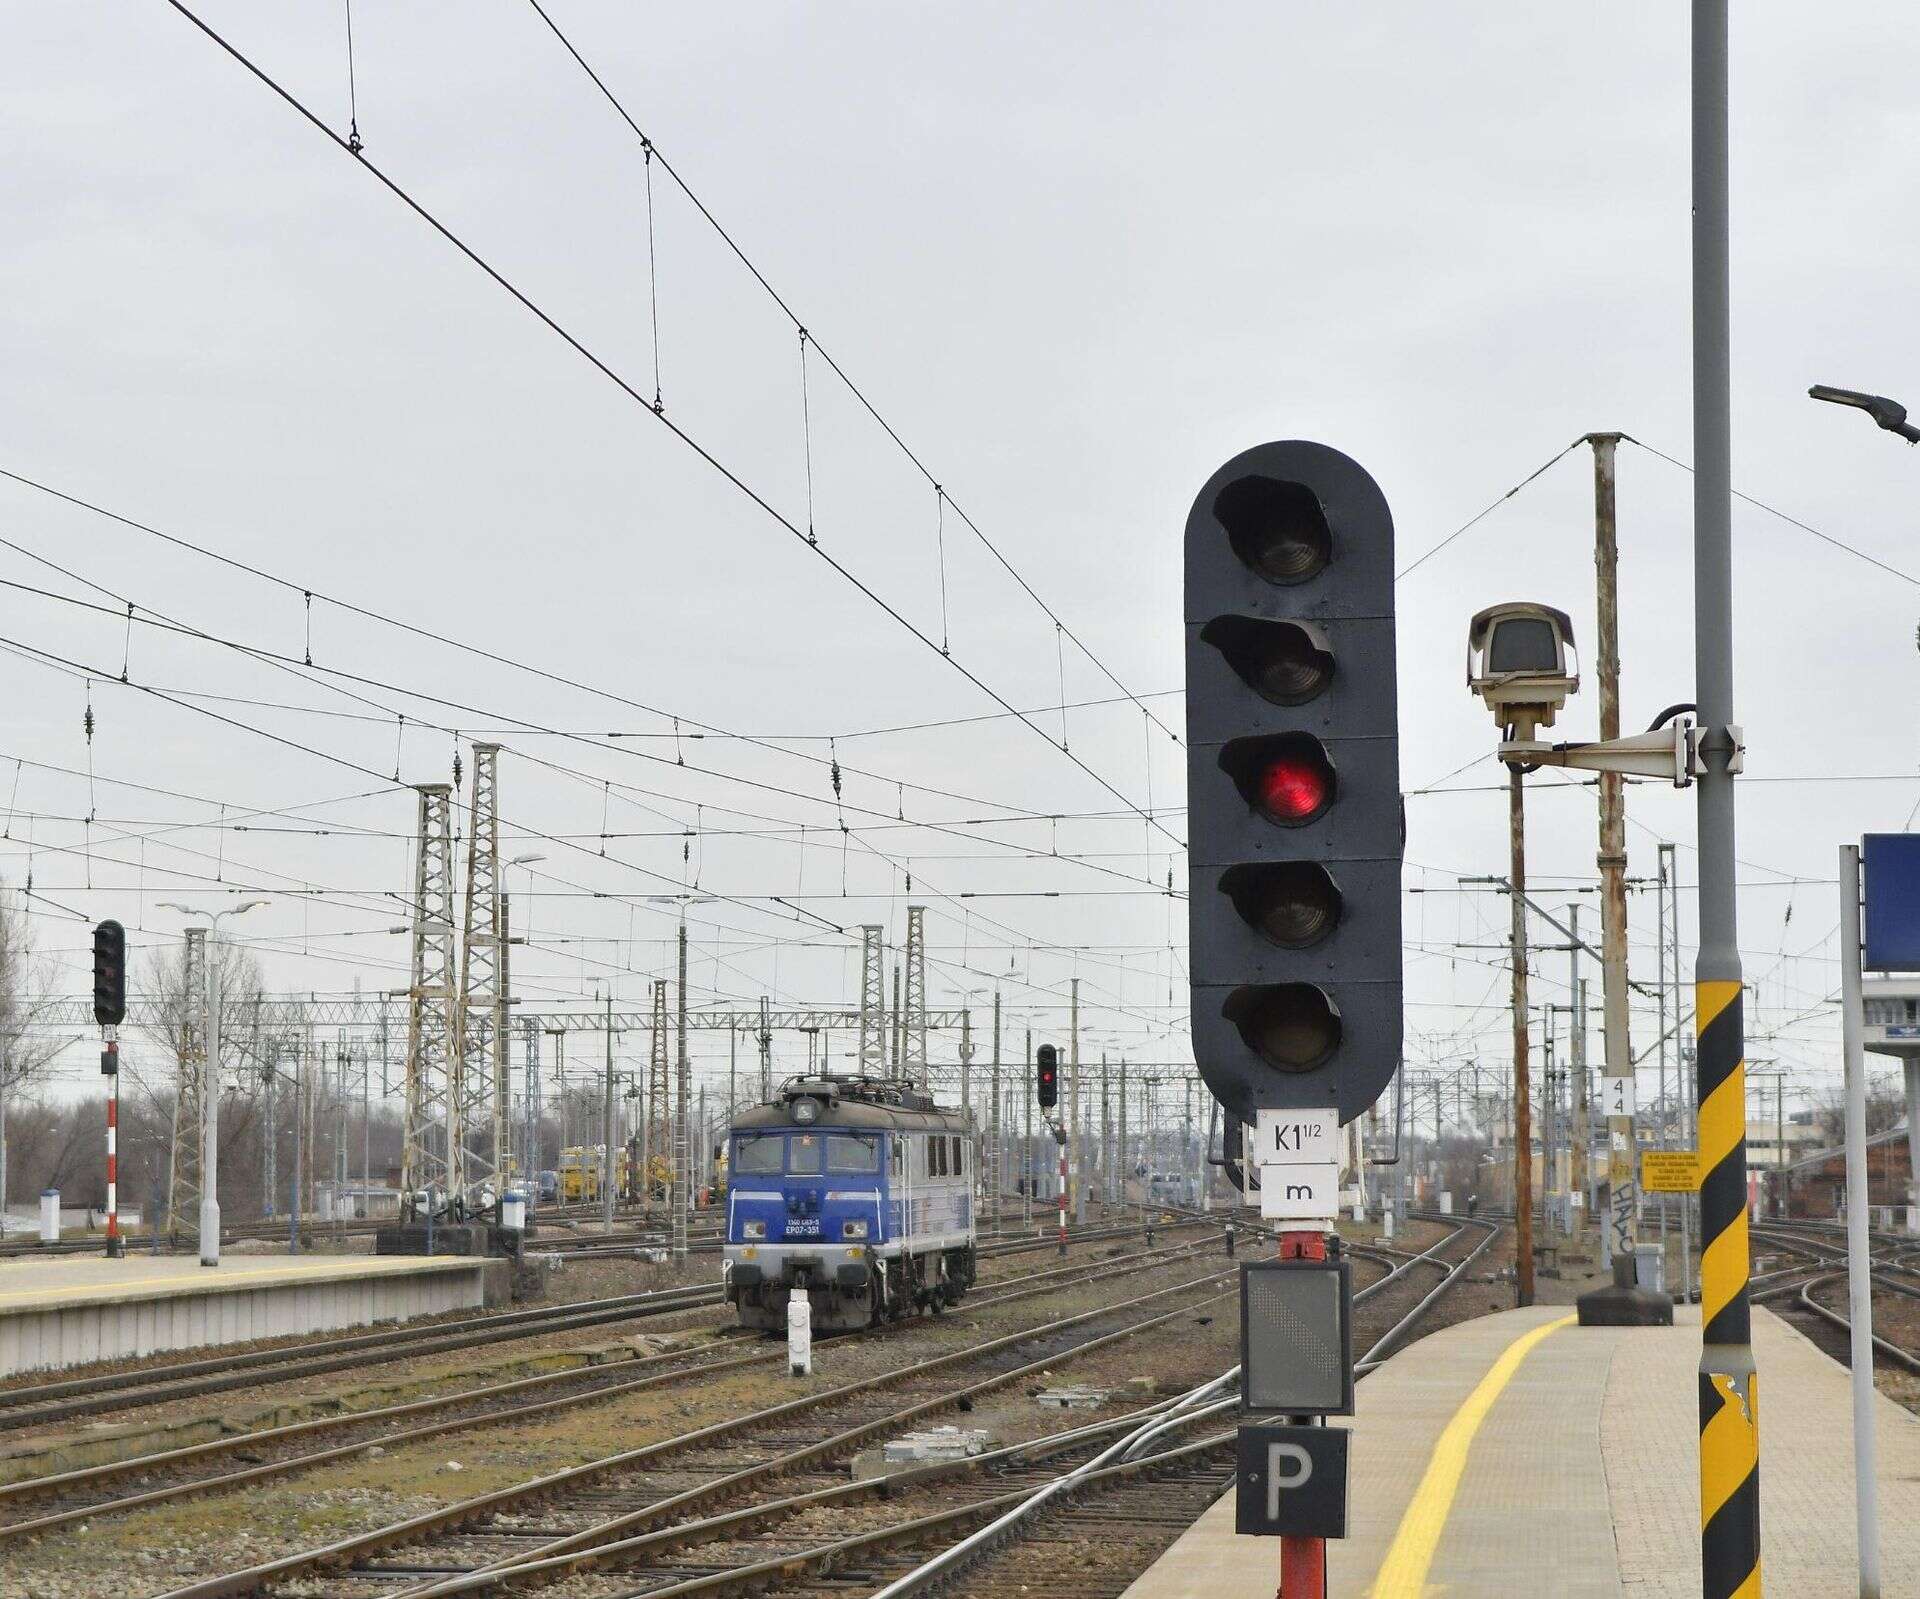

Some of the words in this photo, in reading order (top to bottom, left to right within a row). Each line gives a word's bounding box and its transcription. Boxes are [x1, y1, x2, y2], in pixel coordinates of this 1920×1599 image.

[1614, 1079, 1623, 1094] 4
[1614, 1098, 1623, 1113] 4
[1286, 1184, 1312, 1200] m
[1267, 1442, 1313, 1520] P
